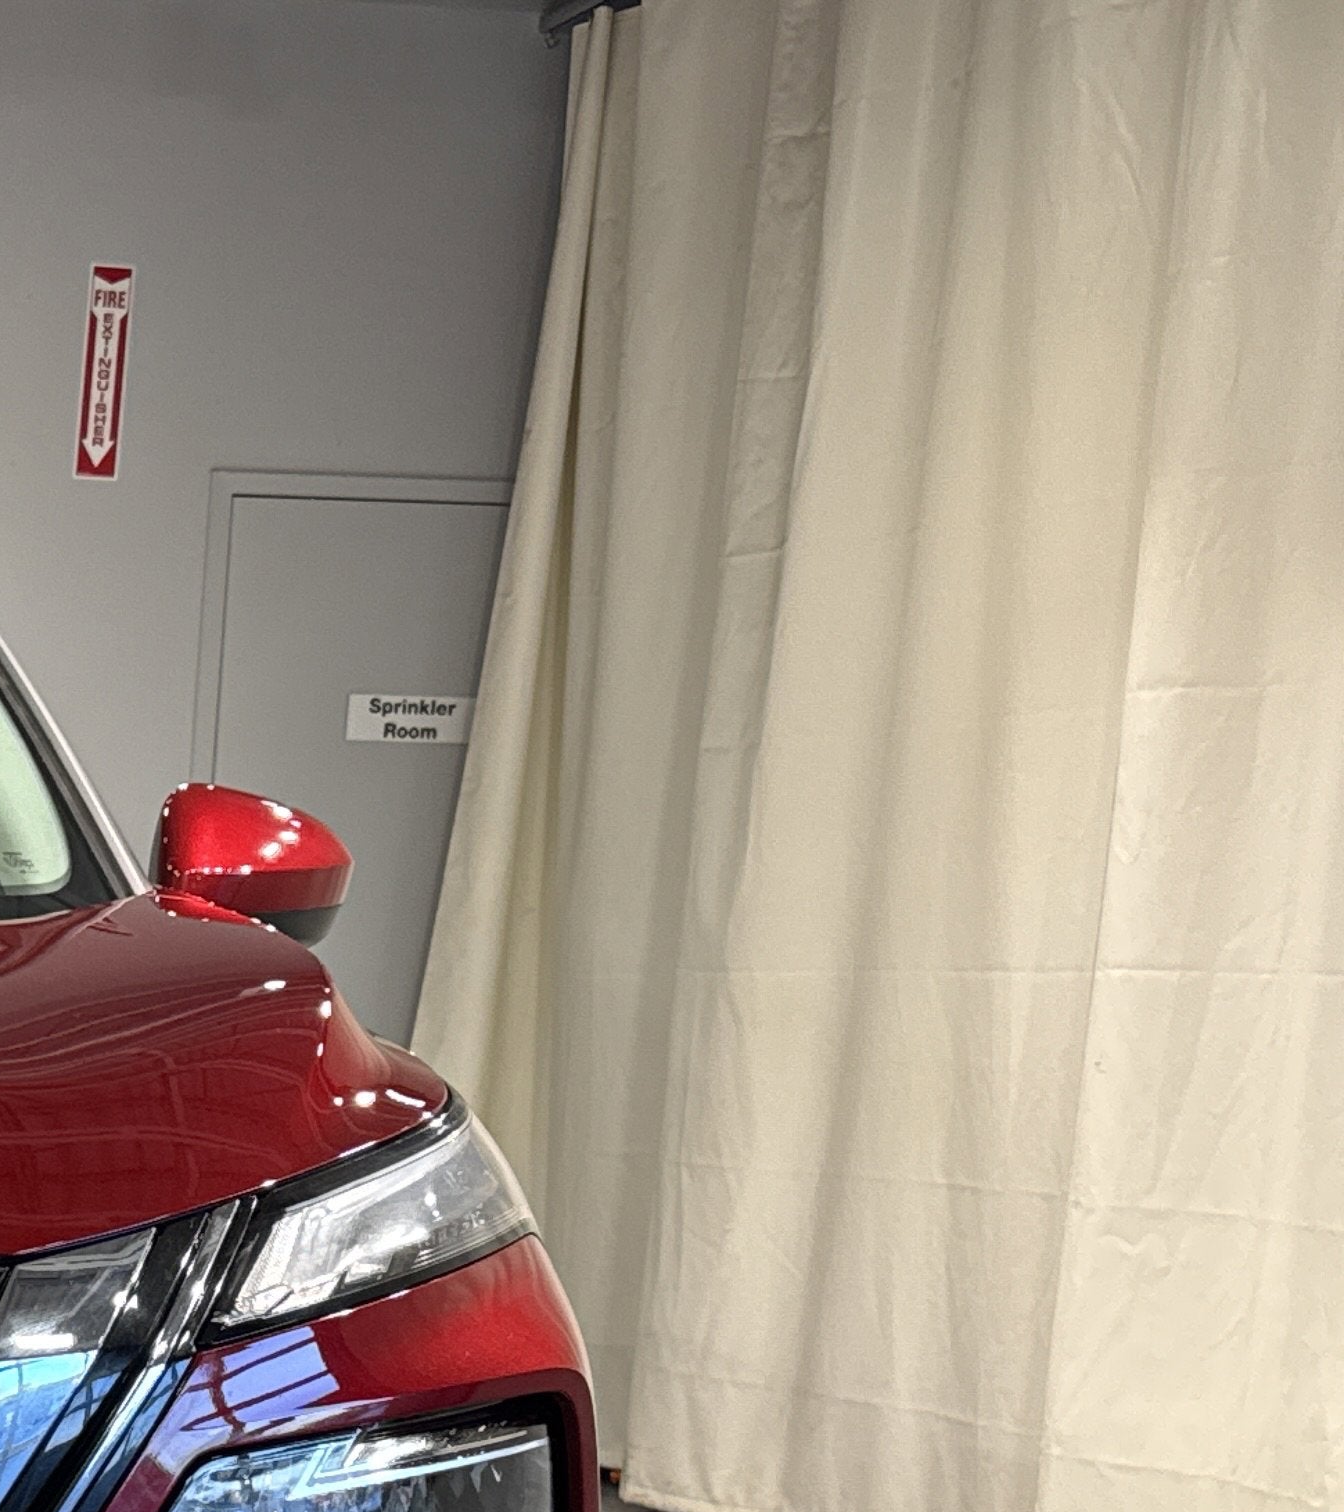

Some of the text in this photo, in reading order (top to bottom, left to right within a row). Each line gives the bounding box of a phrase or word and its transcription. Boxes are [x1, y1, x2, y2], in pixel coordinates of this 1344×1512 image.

[93, 289, 127, 309] FIRE
[92, 313, 115, 448] EXTINGUISHER
[368, 697, 457, 717] Sprinkler
[383, 722, 438, 740] Room
